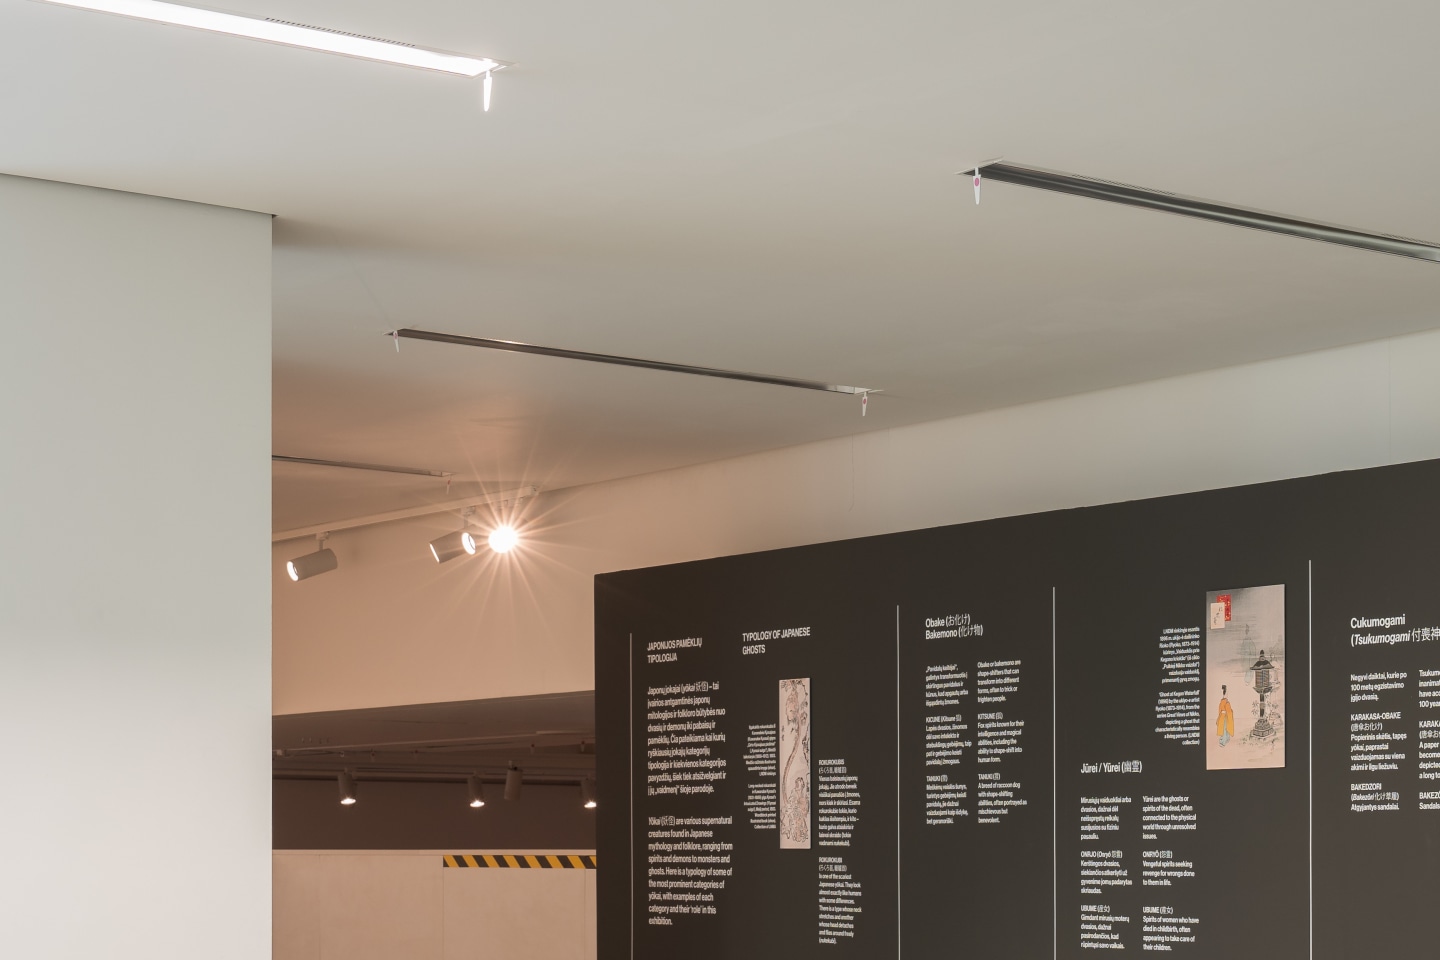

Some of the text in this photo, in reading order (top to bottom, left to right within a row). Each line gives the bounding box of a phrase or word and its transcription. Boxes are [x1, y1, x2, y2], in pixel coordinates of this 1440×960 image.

[1351, 614, 1405, 629] Cukumogami
[742, 627, 810, 642] TYPOLOGY OF JAPANESE
[1351, 630, 1411, 647] (Tsukumogami
[742, 644, 765, 655] GHOSTS
